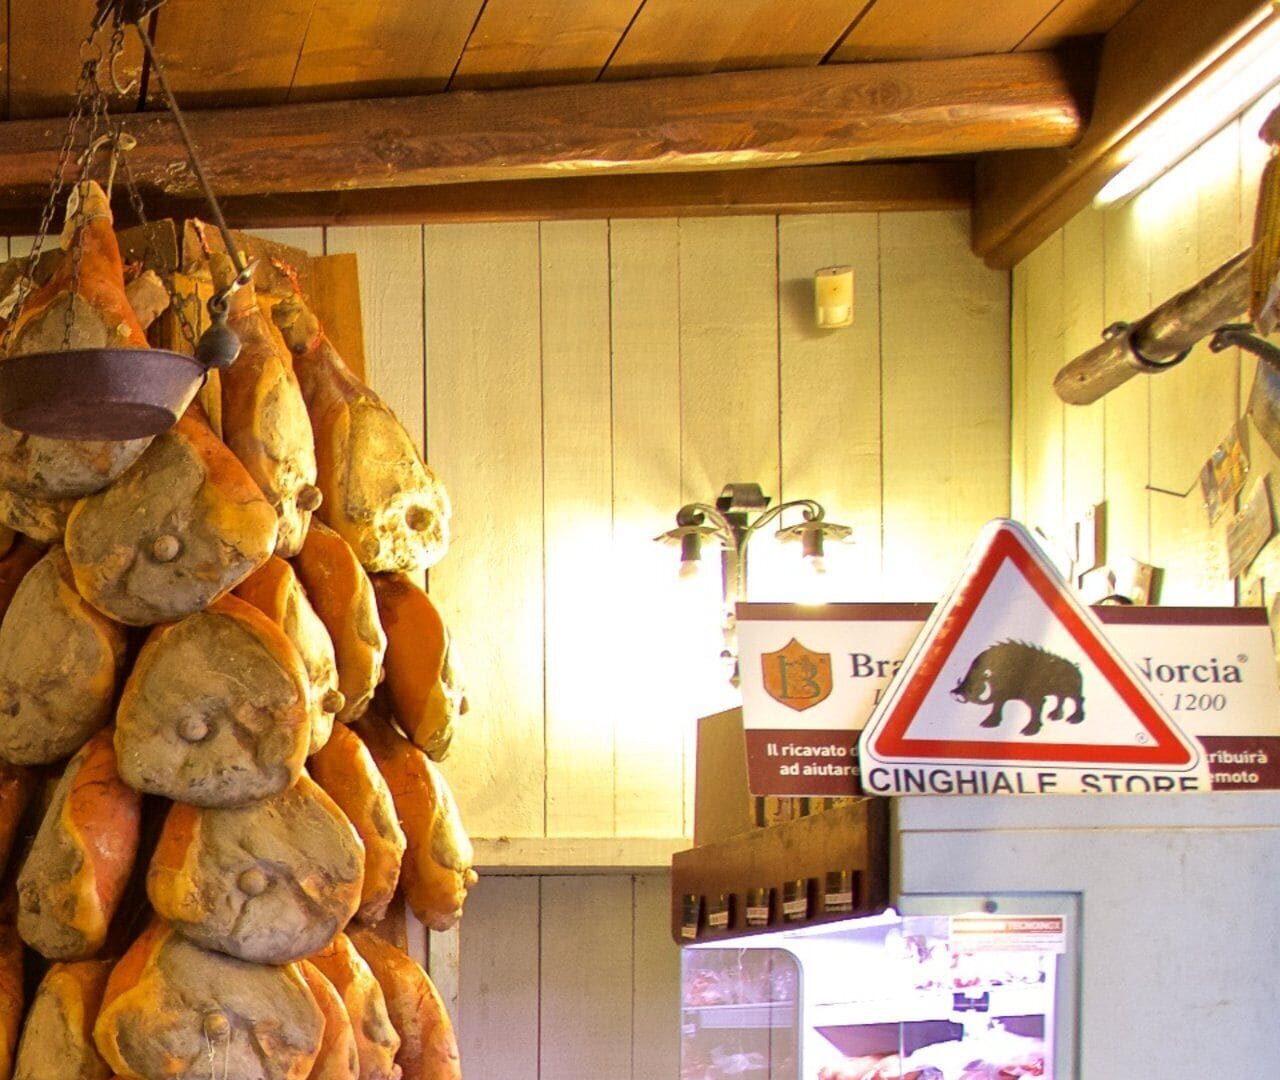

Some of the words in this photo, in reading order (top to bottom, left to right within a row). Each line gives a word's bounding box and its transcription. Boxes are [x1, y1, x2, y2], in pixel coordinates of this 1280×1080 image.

[1173, 693, 1227, 711] 1200
[767, 743, 778, 756] Il
[782, 743, 847, 757] ricavato
[780, 763, 799, 776] ad
[869, 767, 1058, 794] CINGHIALE
[1081, 773, 1200, 793] STORE
